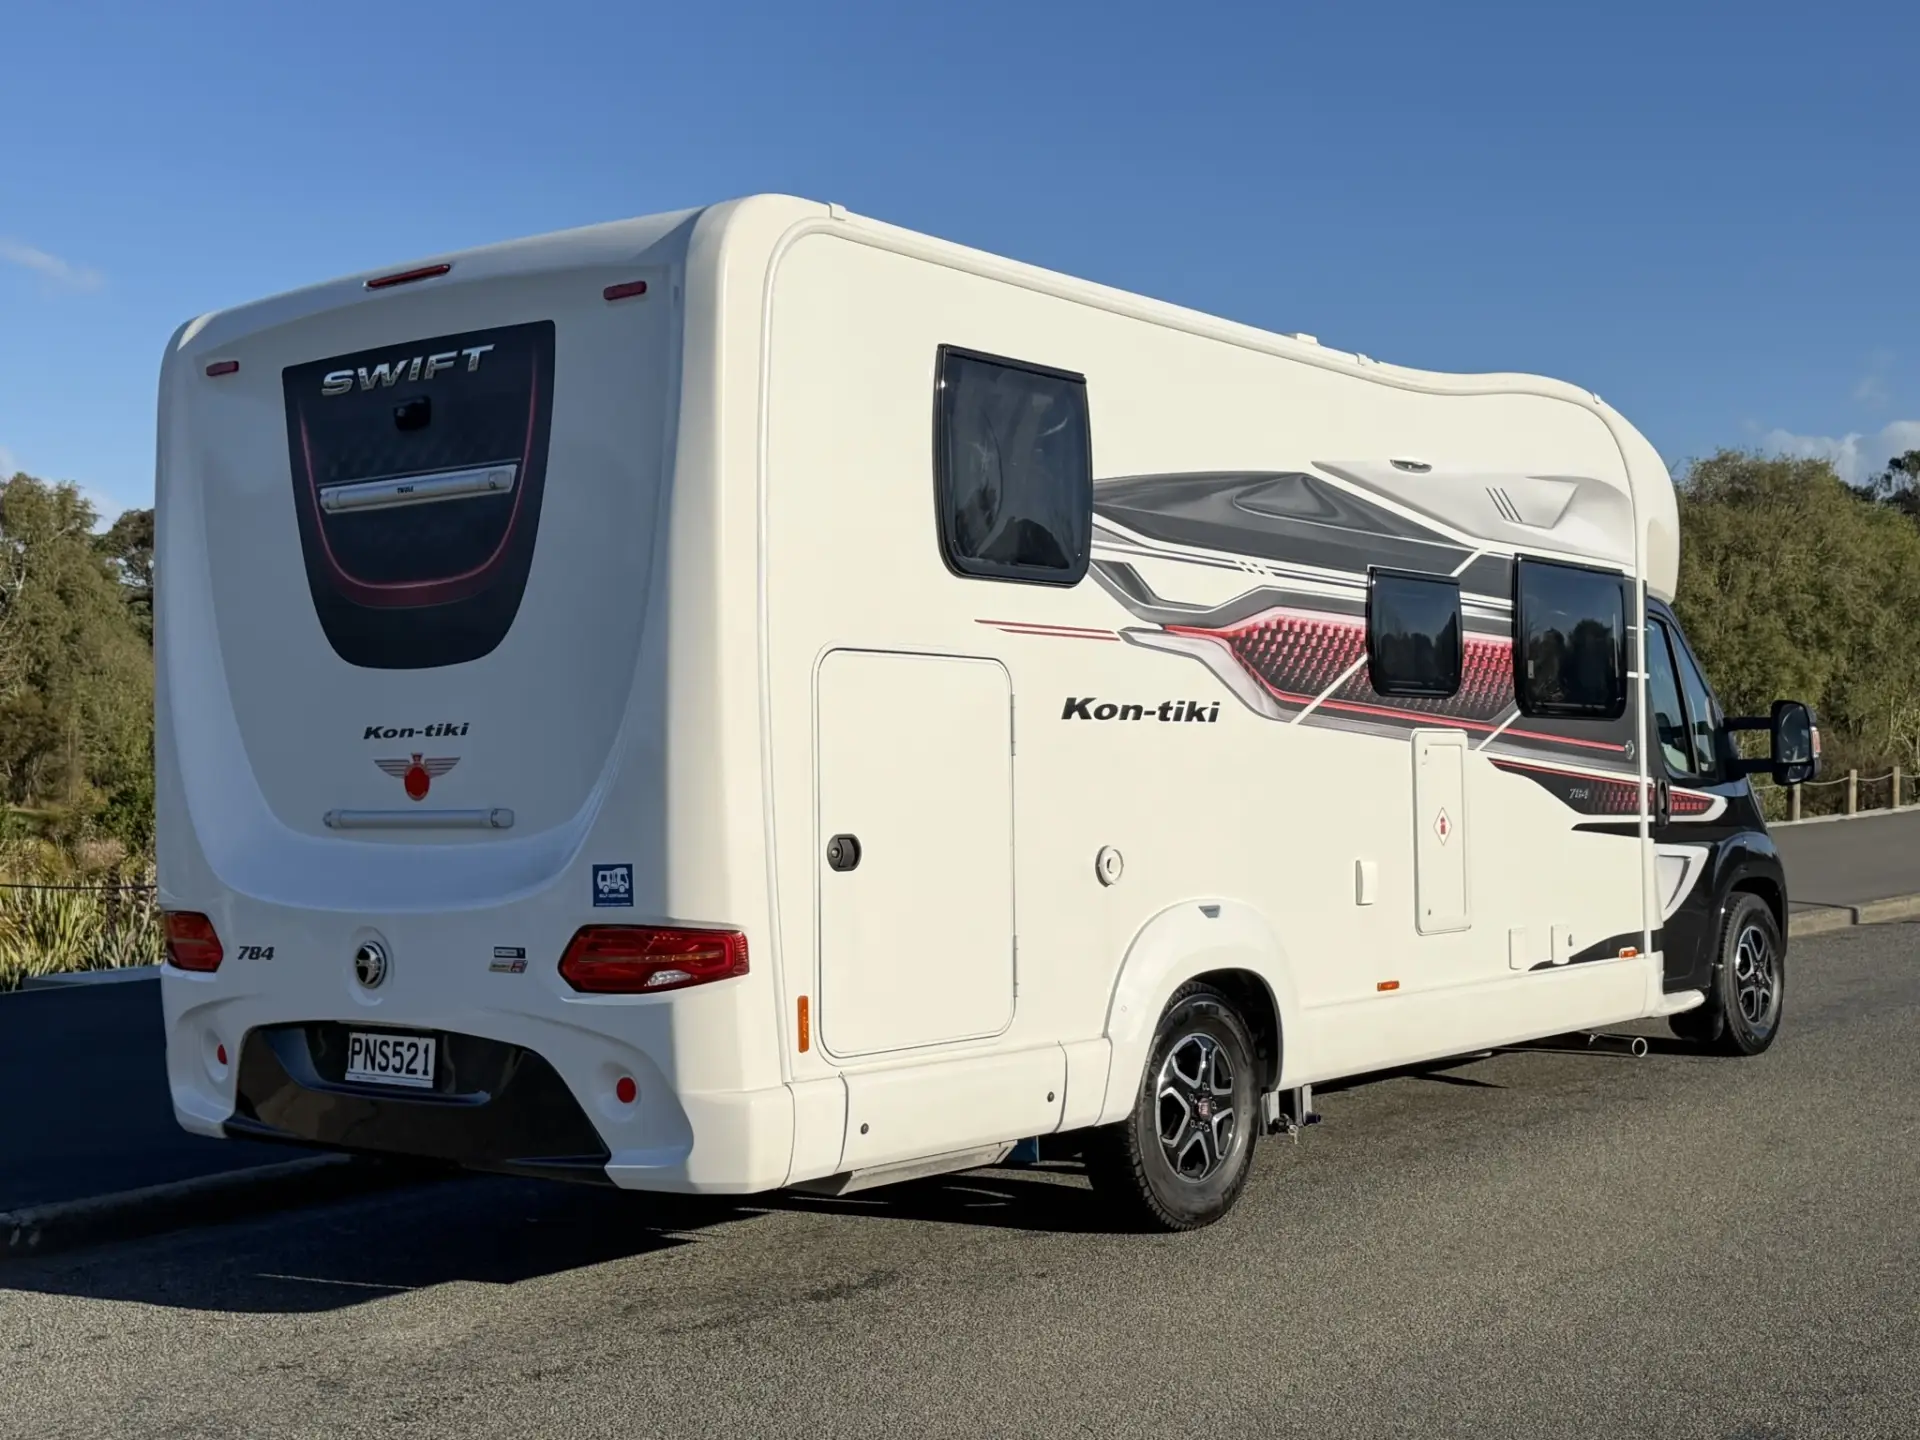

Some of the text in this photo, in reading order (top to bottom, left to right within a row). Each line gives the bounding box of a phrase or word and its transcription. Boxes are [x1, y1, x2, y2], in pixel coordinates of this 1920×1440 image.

[321, 344, 495, 396] SWIFT
[1061, 697, 1220, 723] Kon-tiki
[363, 722, 470, 740] Kon-tiki
[237, 945, 275, 960] 784
[350, 1037, 430, 1076] PNS521
